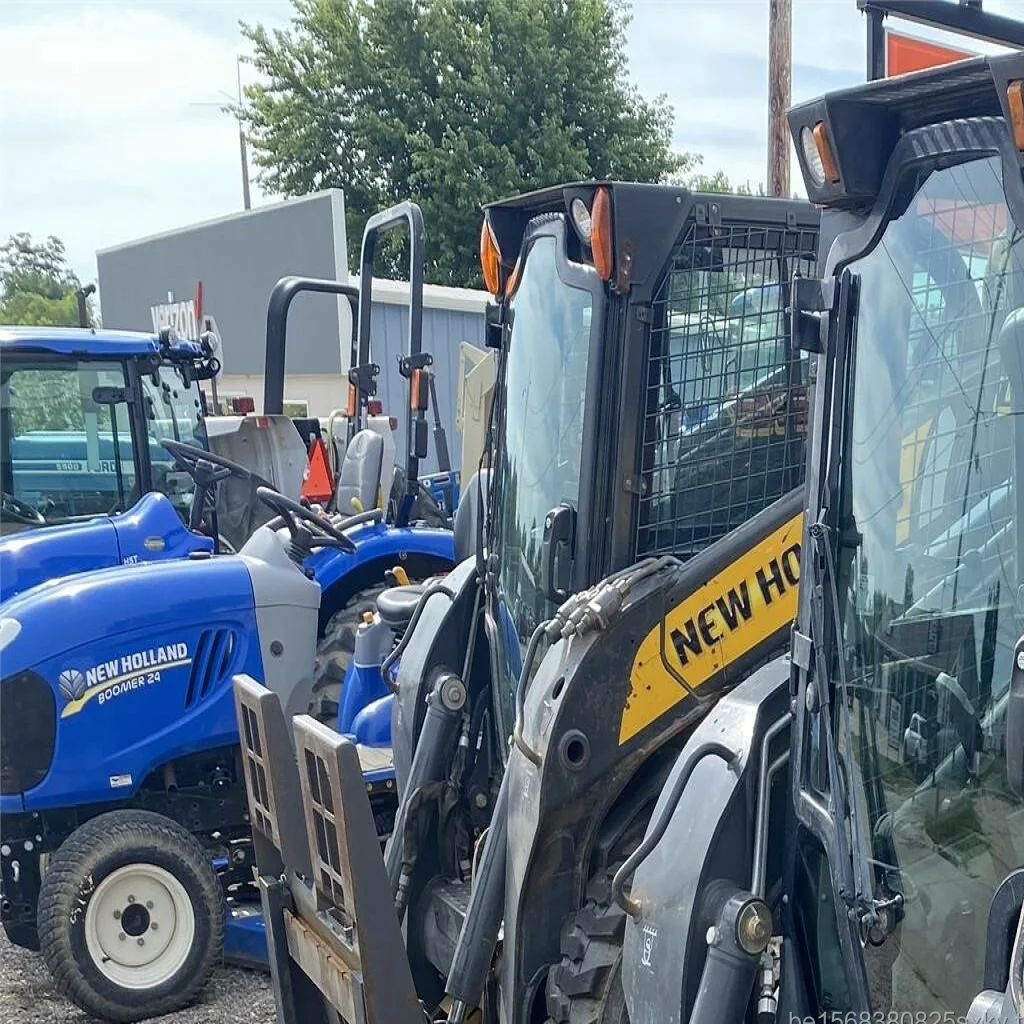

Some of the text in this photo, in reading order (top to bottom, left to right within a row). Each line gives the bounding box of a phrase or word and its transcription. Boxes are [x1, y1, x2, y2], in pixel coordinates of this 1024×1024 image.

[670, 580, 752, 665] NEW
[86, 643, 188, 687] NEW HOLLAND
[98, 671, 161, 704] BOOMER 24
